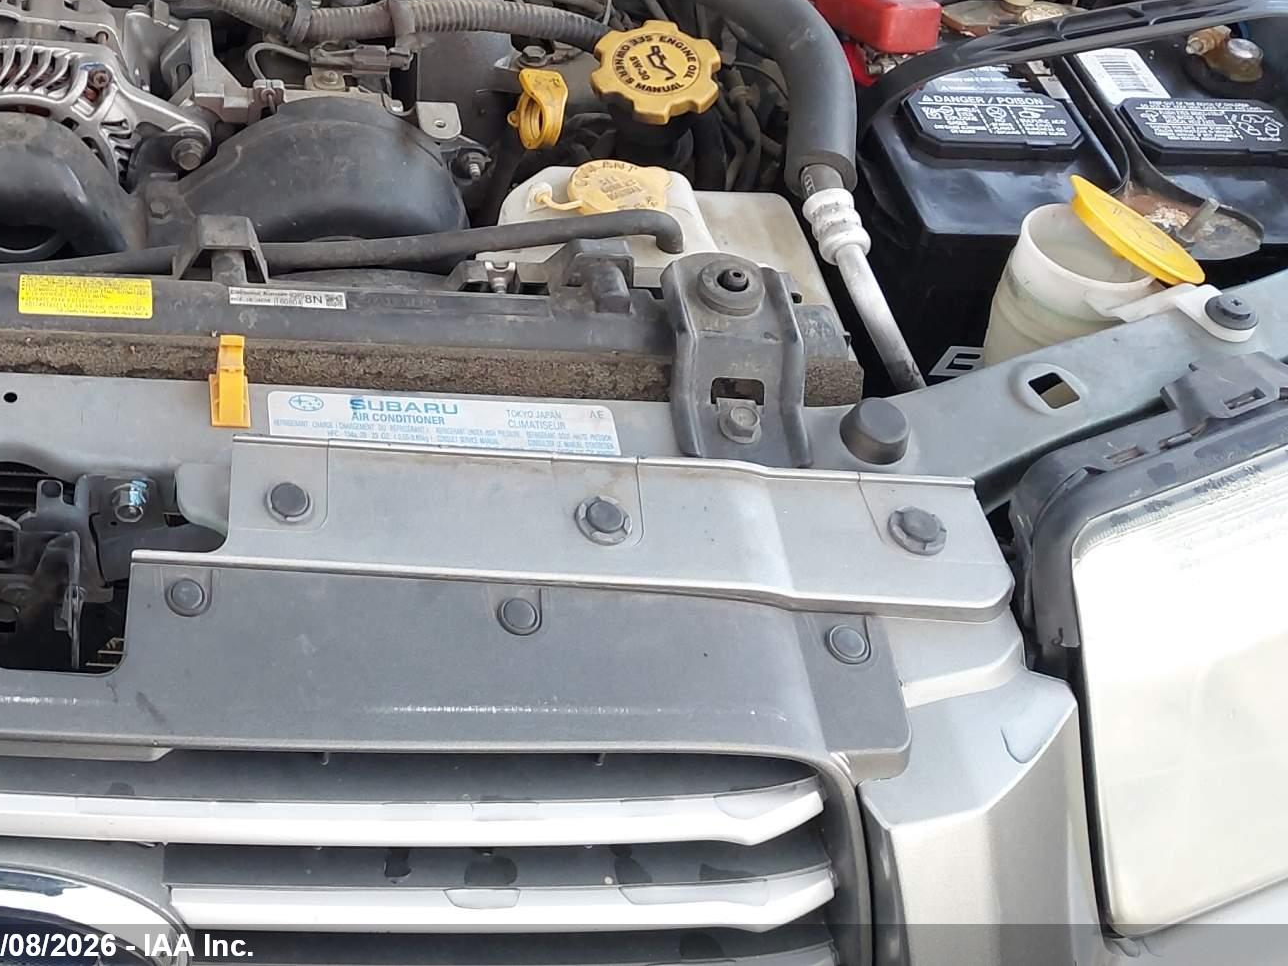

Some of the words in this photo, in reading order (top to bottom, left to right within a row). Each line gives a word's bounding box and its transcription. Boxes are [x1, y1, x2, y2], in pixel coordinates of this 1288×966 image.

[630, 34, 654, 47] SEE
[658, 35, 697, 63] ENGINE
[683, 65, 698, 80] OIL
[614, 45, 635, 85] OWNER'S
[629, 55, 651, 82] 5W-30
[634, 81, 685, 94] MANUAL
[934, 94, 986, 105] DANGER
[996, 96, 1044, 106] POISON
[304, 294, 323, 305] 8N
[349, 396, 458, 415] SUBARU
[351, 412, 370, 422] AIR
[373, 412, 445, 426] CONDITIONER
[506, 409, 534, 419] TOKYO
[536, 410, 562, 419] JAPAN
[507, 420, 566, 431] CLIMATISEUR
